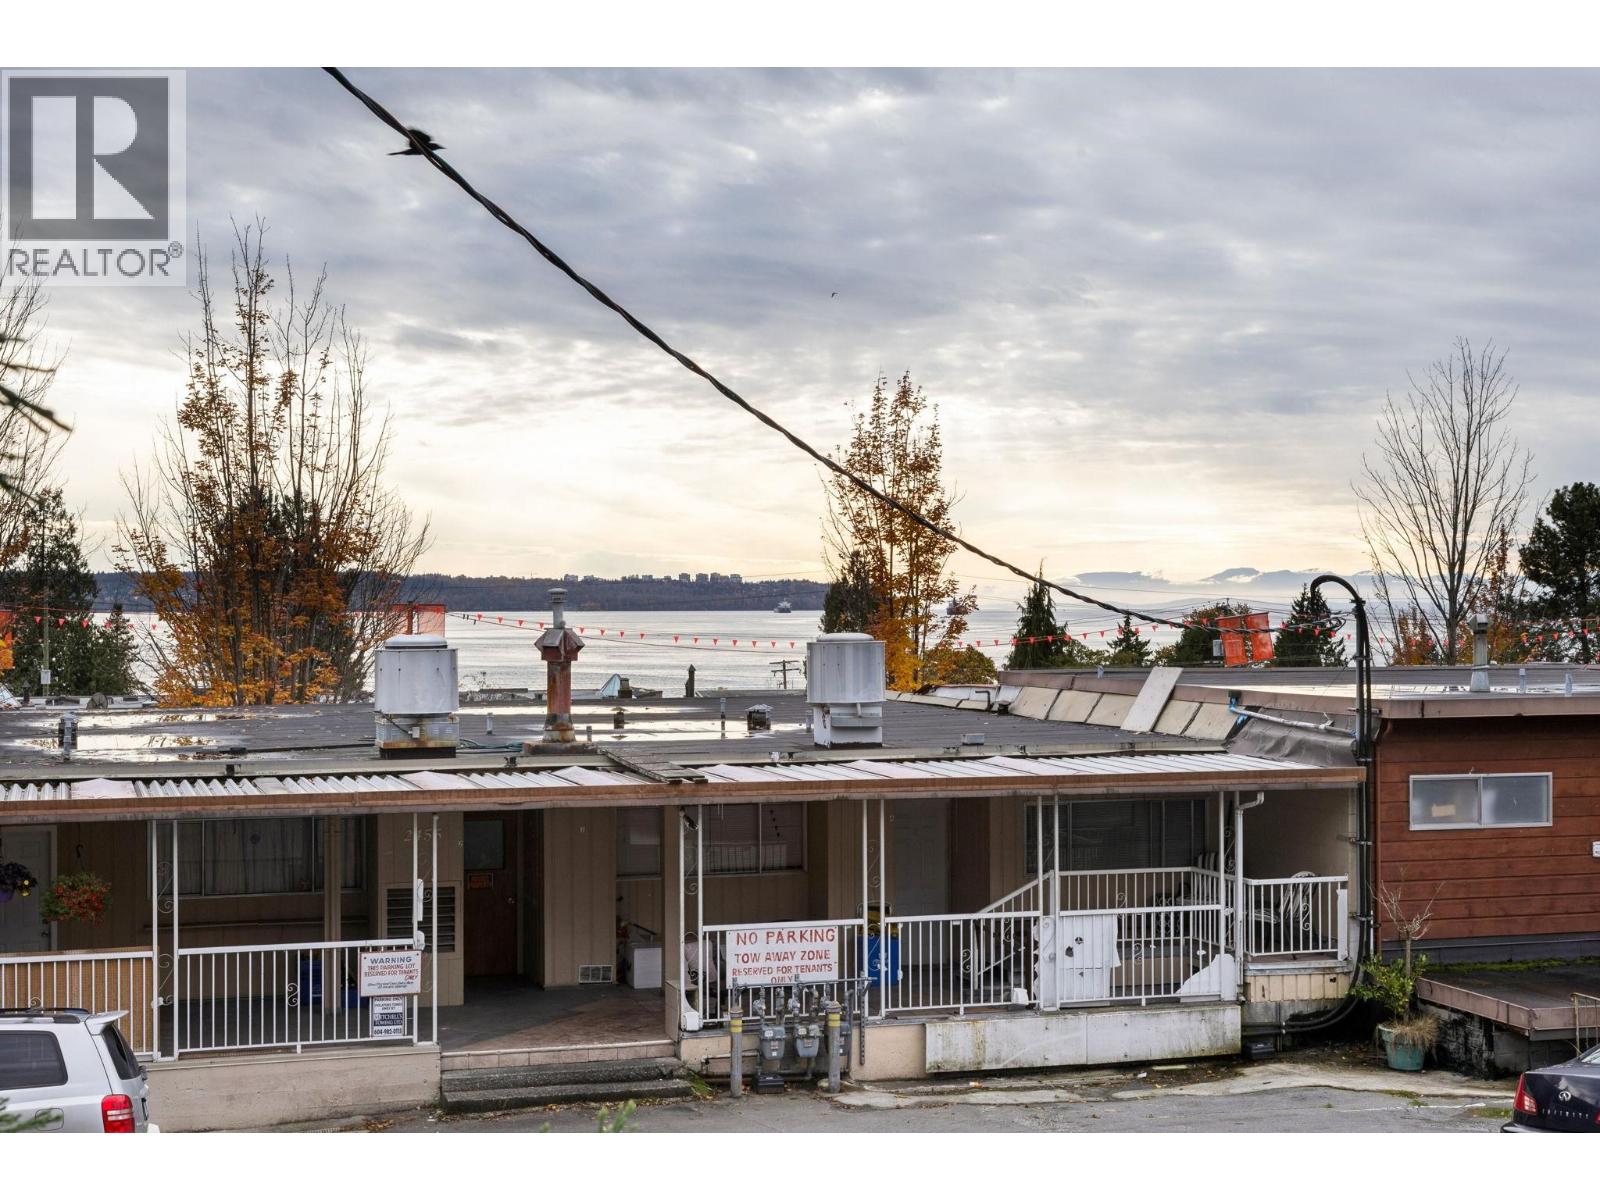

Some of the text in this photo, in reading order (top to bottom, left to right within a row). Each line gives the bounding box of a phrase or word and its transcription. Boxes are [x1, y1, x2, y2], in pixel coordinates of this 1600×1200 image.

[736, 928, 836, 946] NO PARKING
[370, 956, 412, 964] WARNING
[734, 949, 831, 964] TOW AWAY ZONE
[732, 963, 833, 977] RESERVED FOR TENANTS
[770, 976, 793, 984] ONLY
